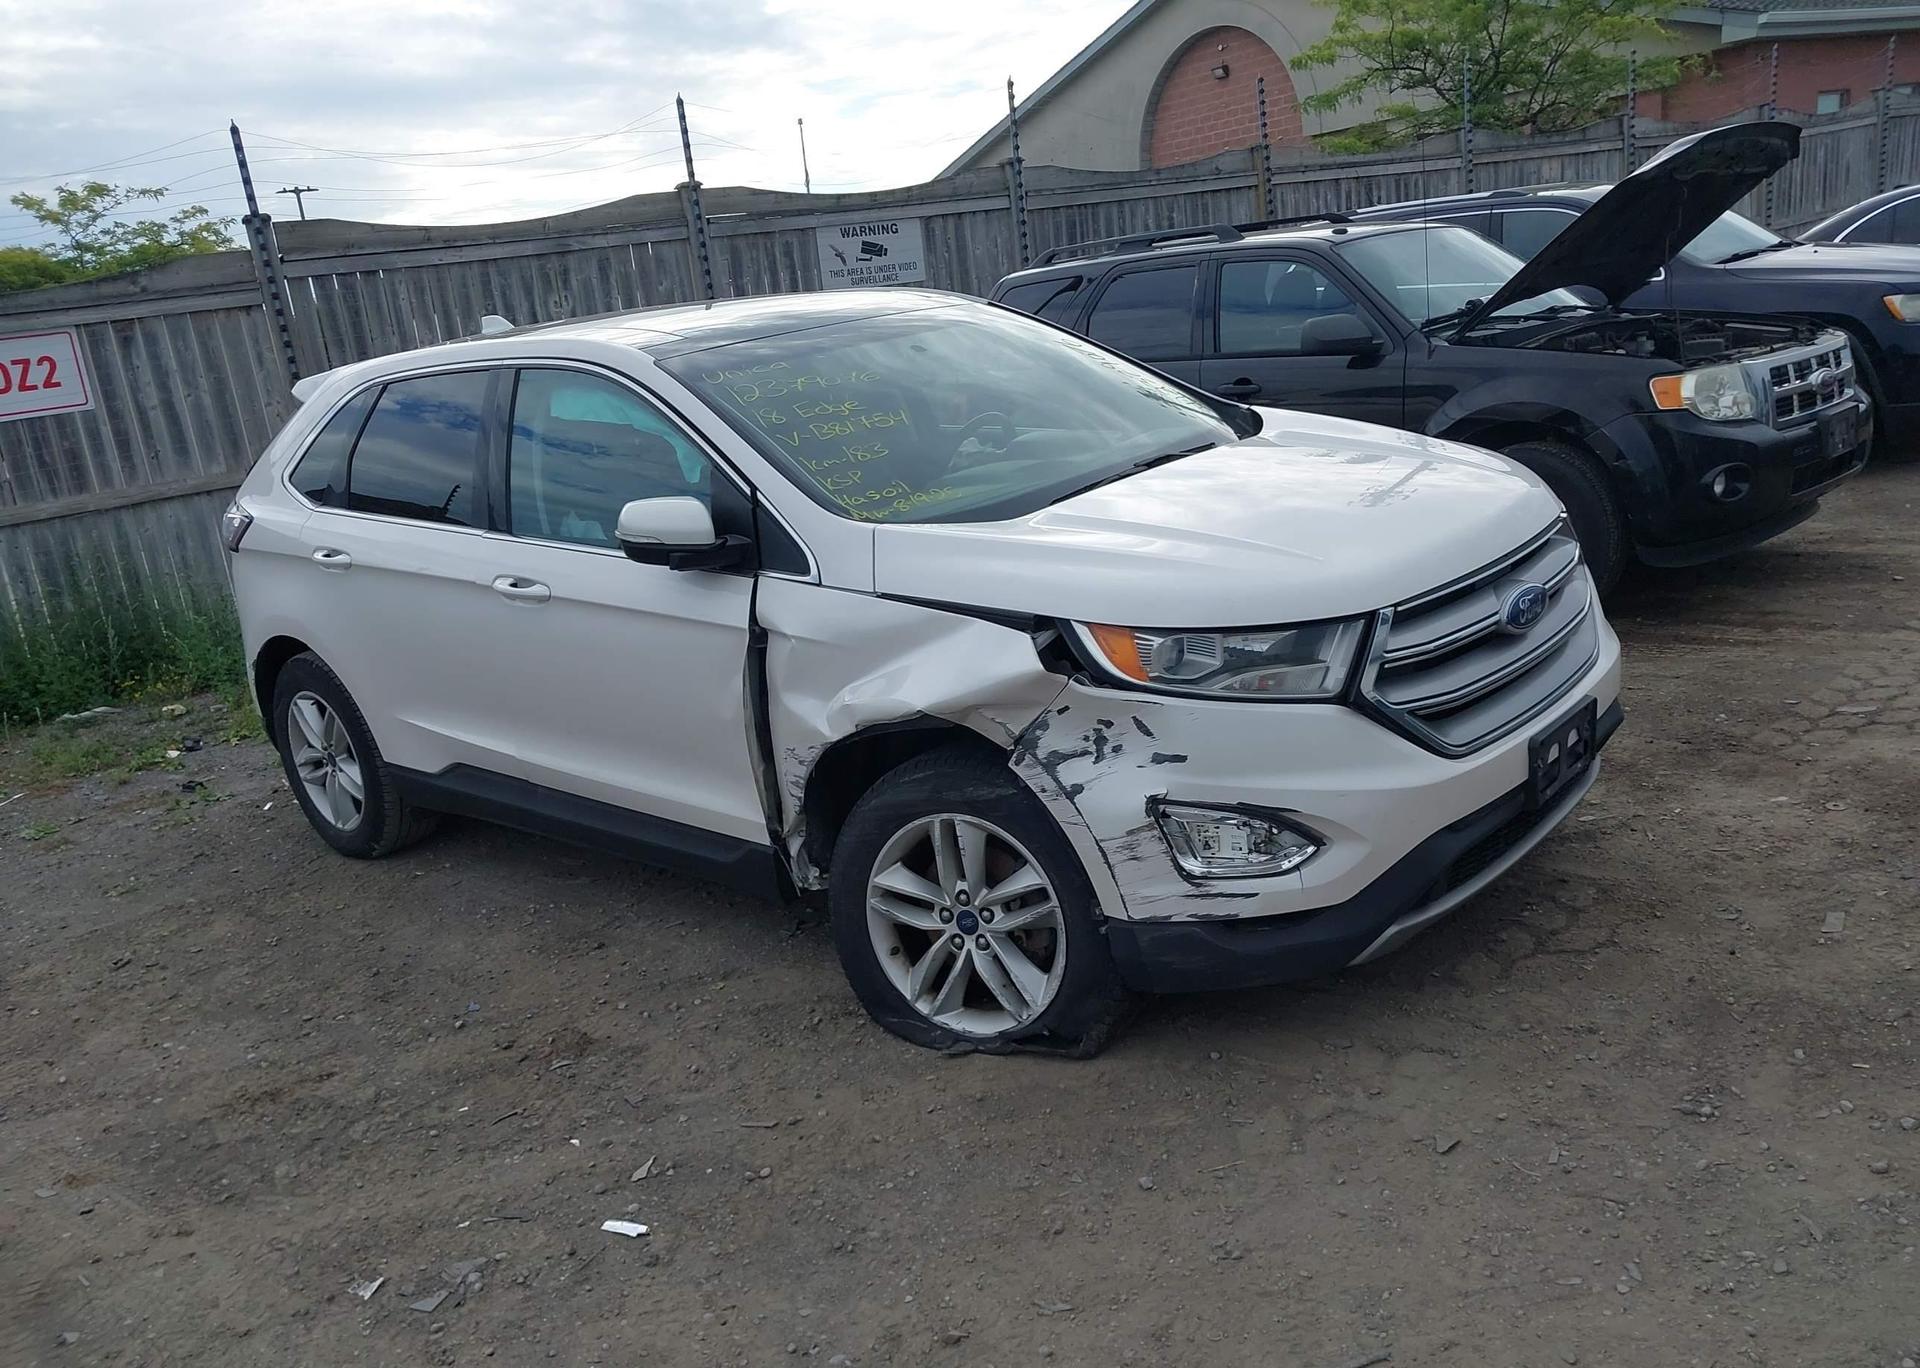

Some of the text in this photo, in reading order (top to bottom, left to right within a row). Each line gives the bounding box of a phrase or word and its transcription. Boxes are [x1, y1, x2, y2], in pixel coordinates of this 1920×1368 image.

[840, 223, 899, 239] WARNING
[829, 261, 918, 279] THIS AREA IS UNDER VIDEO
[850, 273, 900, 287] SURVEILLANCE
[751, 400, 868, 429] 18 Edge
[1519, 592, 1542, 623] Ford
